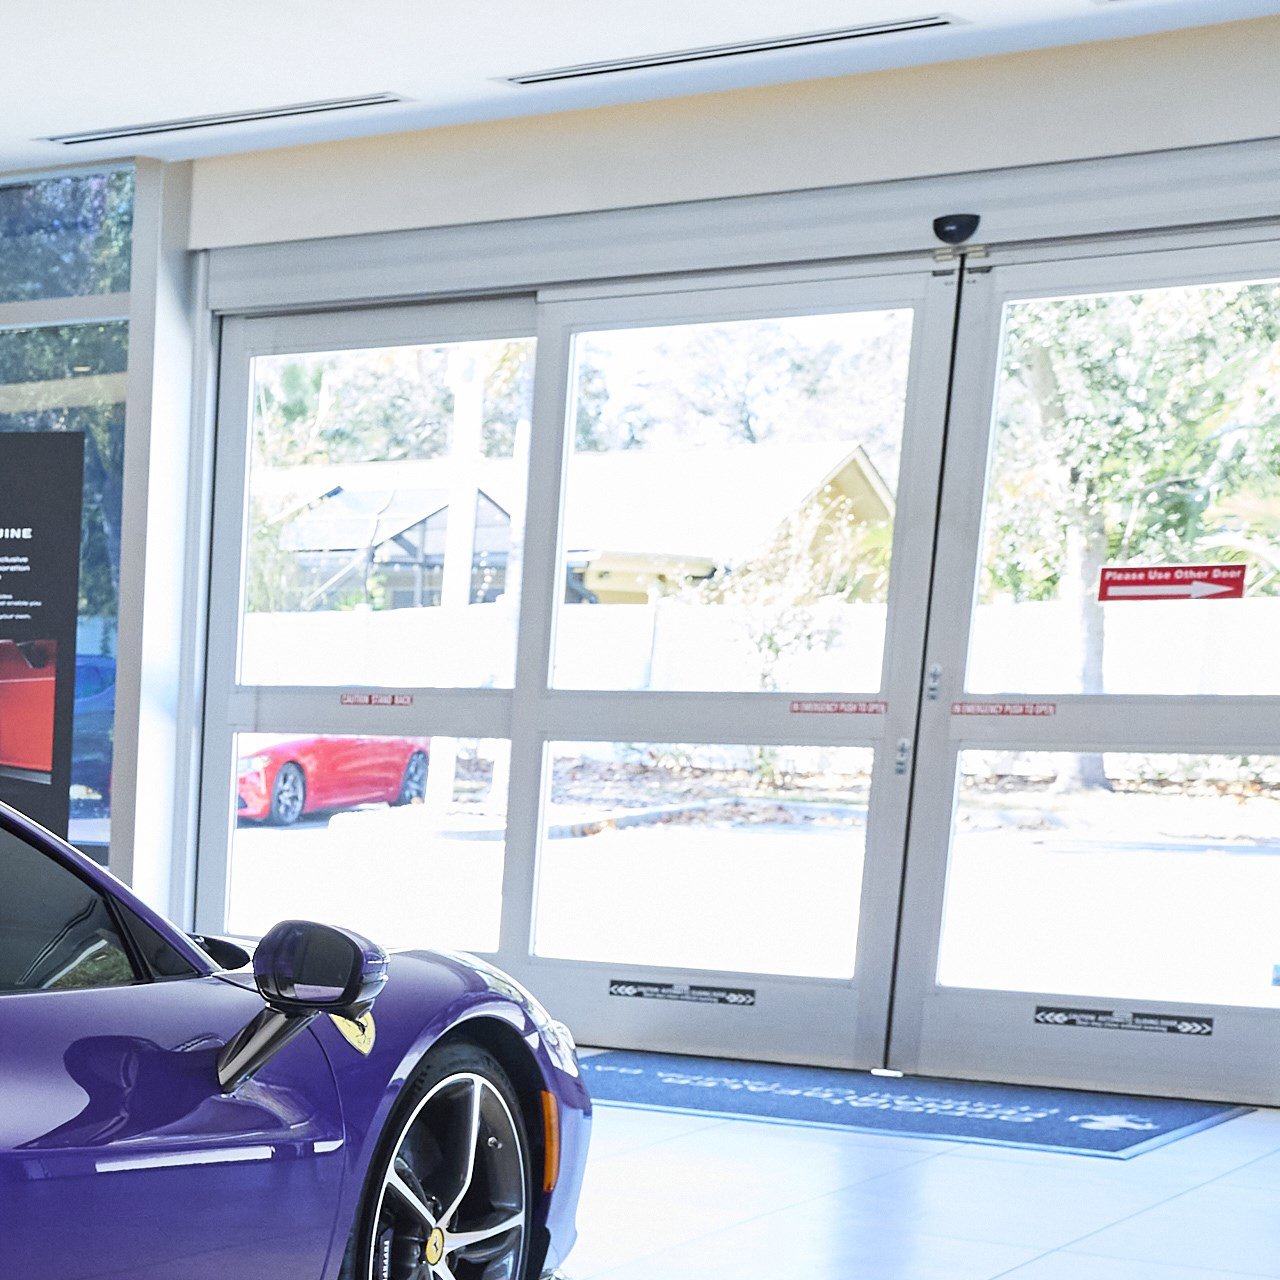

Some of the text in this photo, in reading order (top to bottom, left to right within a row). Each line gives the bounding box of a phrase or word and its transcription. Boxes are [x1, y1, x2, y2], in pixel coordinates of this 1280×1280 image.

[1104, 569, 1241, 581] Please Use Other Door
